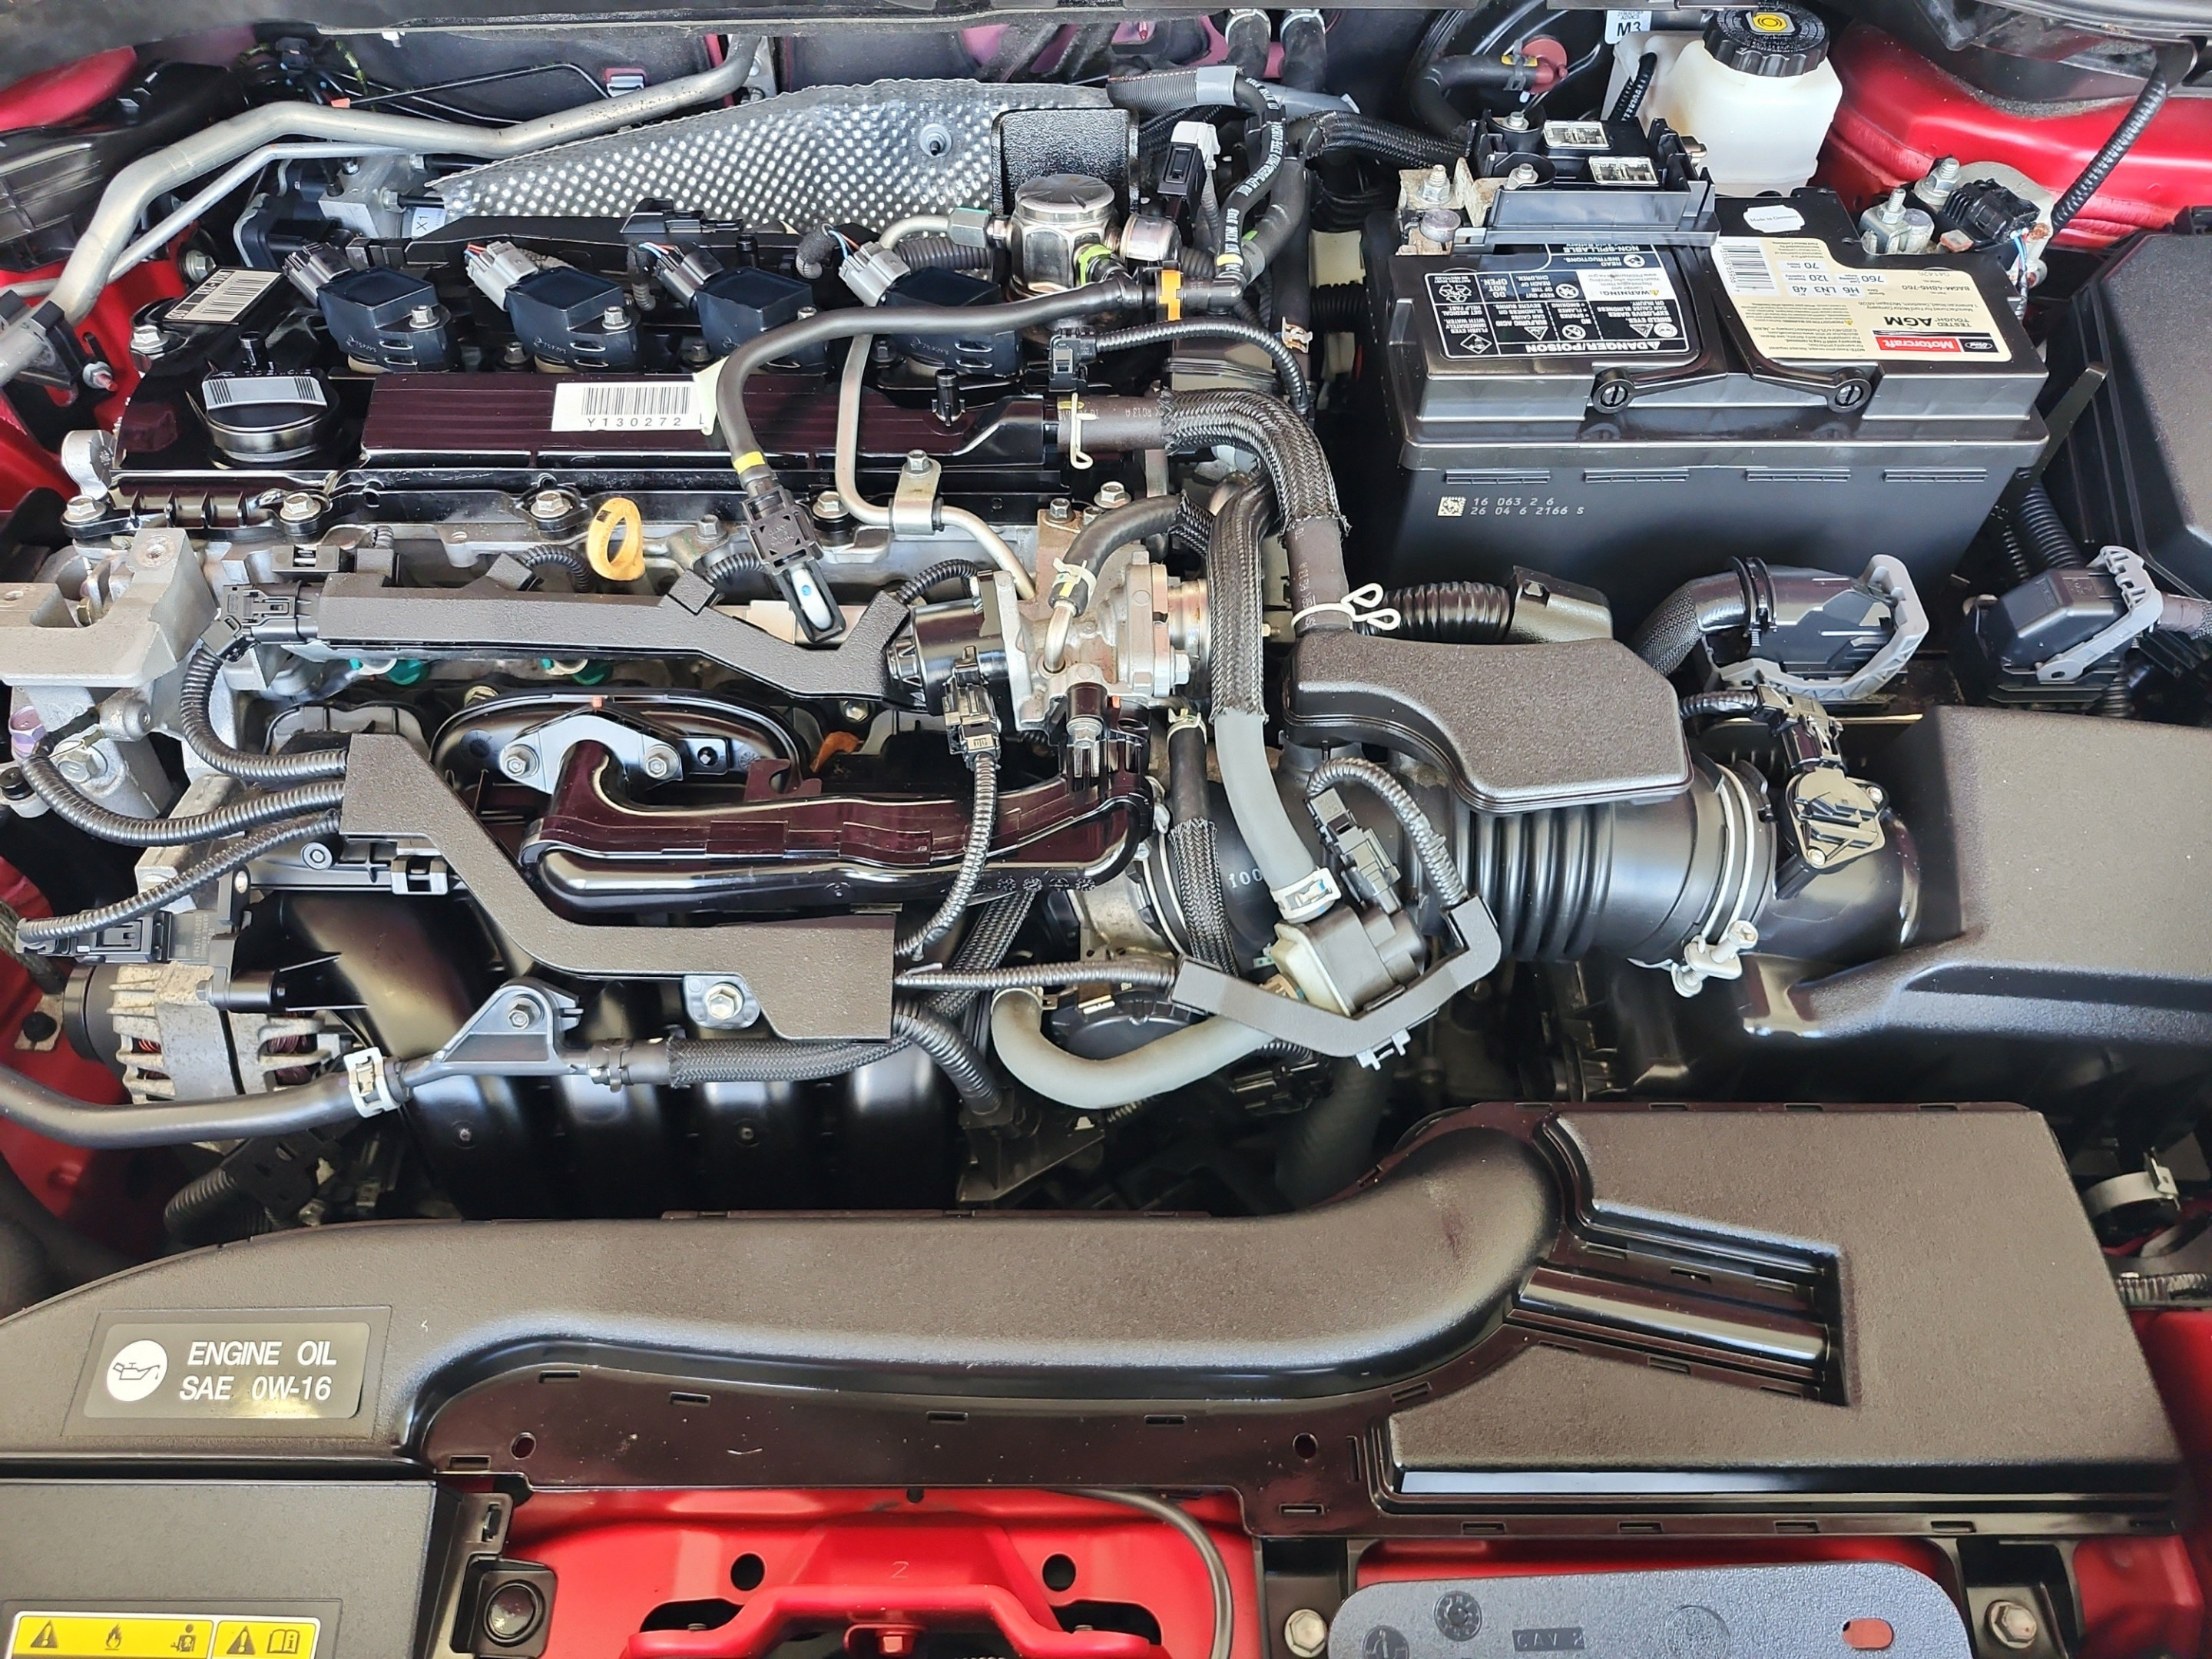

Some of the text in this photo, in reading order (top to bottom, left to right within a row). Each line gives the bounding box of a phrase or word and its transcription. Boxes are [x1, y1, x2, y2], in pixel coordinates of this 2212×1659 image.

[1617, 22, 1641, 36] M3
[1883, 316, 1932, 326] AGM
[1525, 342, 1648, 353] DANGER/POISON
[1882, 339, 1954, 349] Motorcraft
[587, 417, 681, 427] Y130272
[1473, 498, 1554, 506] 16 063 2 6
[1470, 507, 1585, 515] 26 04 6 2166 S
[187, 1340, 337, 1366] ENGINE OIL
[179, 1375, 333, 1401] SAE 0W-16
[891, 1561, 909, 1580] 2
